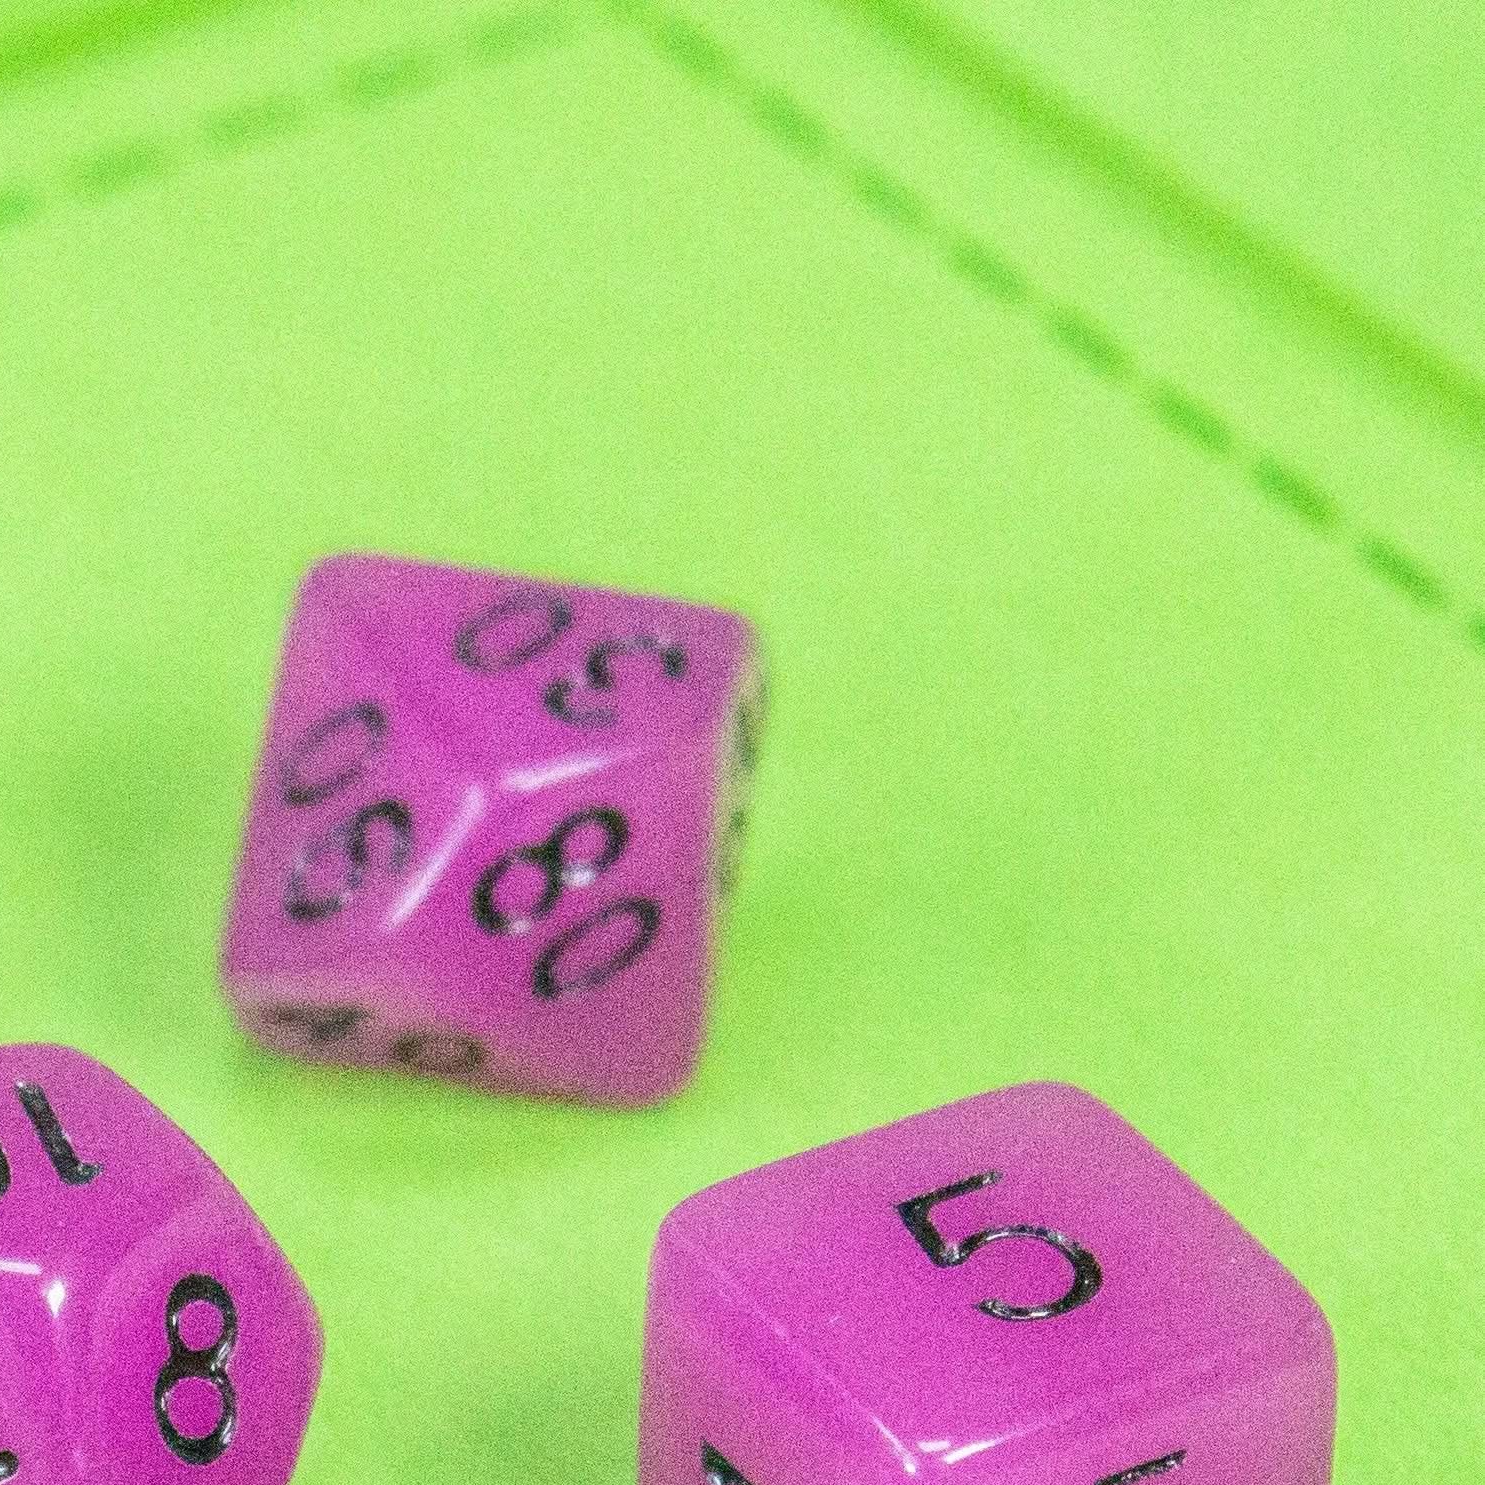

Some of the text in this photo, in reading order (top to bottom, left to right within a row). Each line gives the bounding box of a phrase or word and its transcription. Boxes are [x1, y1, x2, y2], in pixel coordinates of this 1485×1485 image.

[453, 590, 689, 730] 30
[472, 803, 663, 1000] 80
[894, 1170, 1104, 1322] 5
[153, 1272, 239, 1466] 8
